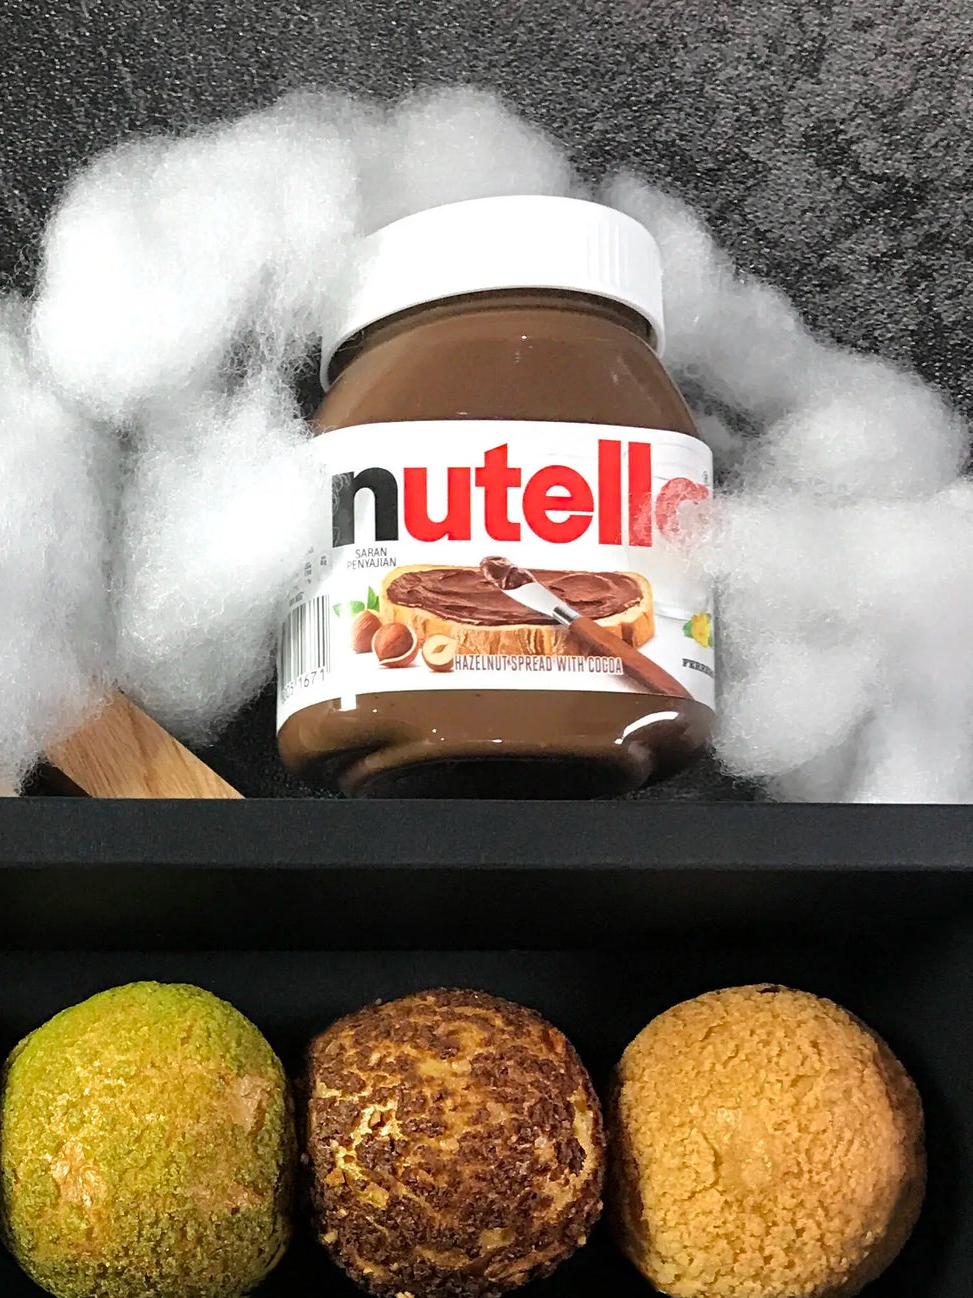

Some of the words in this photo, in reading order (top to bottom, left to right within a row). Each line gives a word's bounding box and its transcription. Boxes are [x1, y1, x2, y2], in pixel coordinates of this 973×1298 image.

[355, 547, 388, 559] SARAN
[347, 557, 397, 569] PENYAJIAN
[455, 654, 507, 671] HAZELNUT
[511, 655, 552, 672] SPREAD
[556, 656, 584, 673] WITH
[588, 657, 623, 675] COCOA
